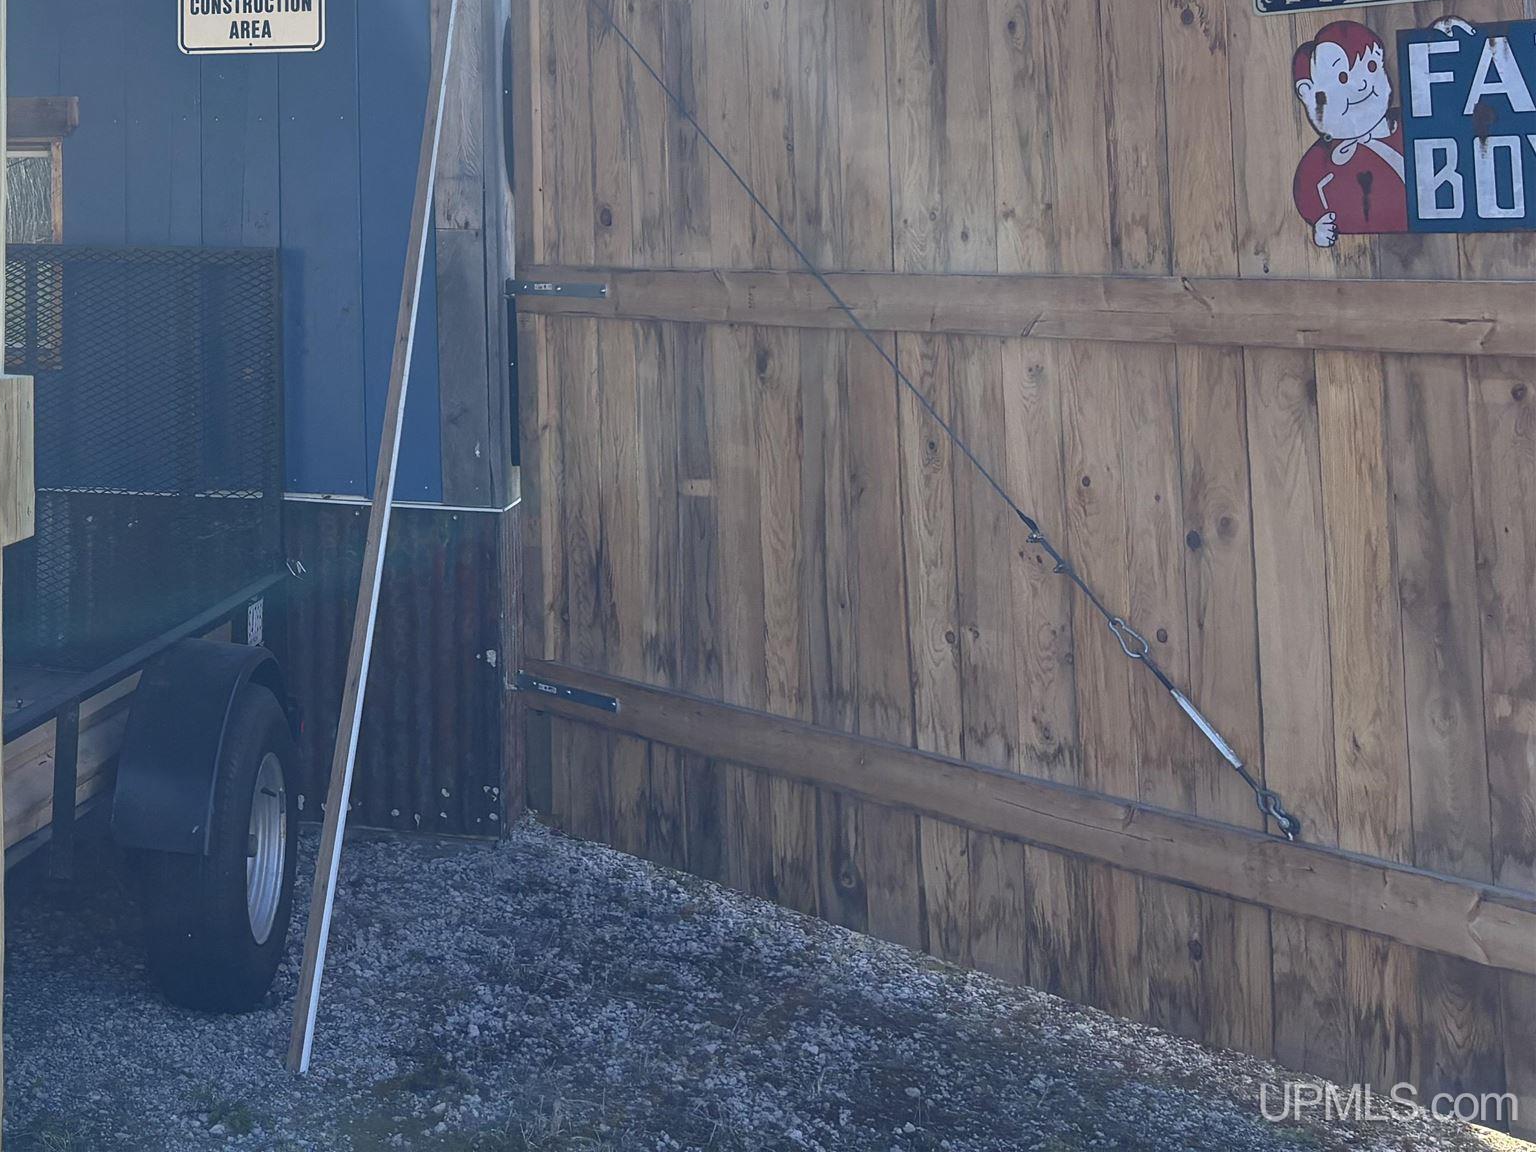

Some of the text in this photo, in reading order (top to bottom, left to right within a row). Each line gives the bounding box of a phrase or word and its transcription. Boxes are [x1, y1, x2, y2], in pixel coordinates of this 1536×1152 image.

[229, 19, 272, 39] AREA
[1408, 35, 1536, 118] FA
[1413, 135, 1536, 219] BO
